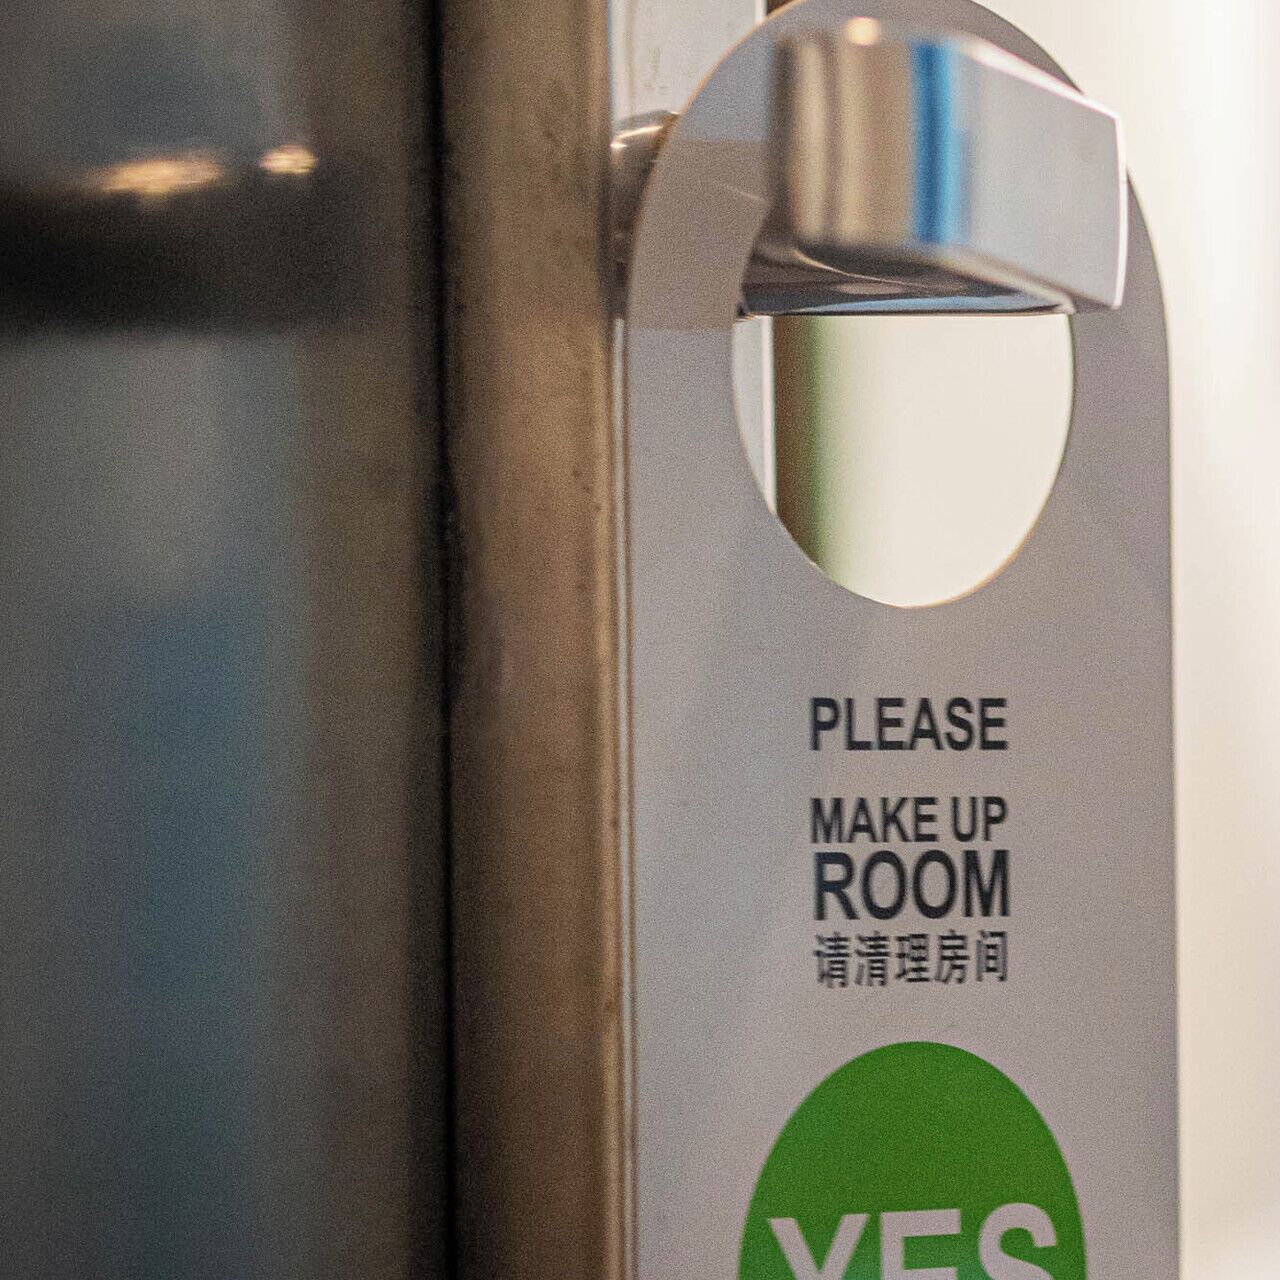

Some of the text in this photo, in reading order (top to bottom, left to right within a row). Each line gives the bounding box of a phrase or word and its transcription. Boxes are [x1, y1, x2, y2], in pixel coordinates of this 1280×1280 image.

[810, 697, 1008, 751] PLEASE
[810, 796, 1008, 843] MAKE UP
[813, 849, 1010, 920] ROOM
[813, 930, 1008, 988] 请清理房间
